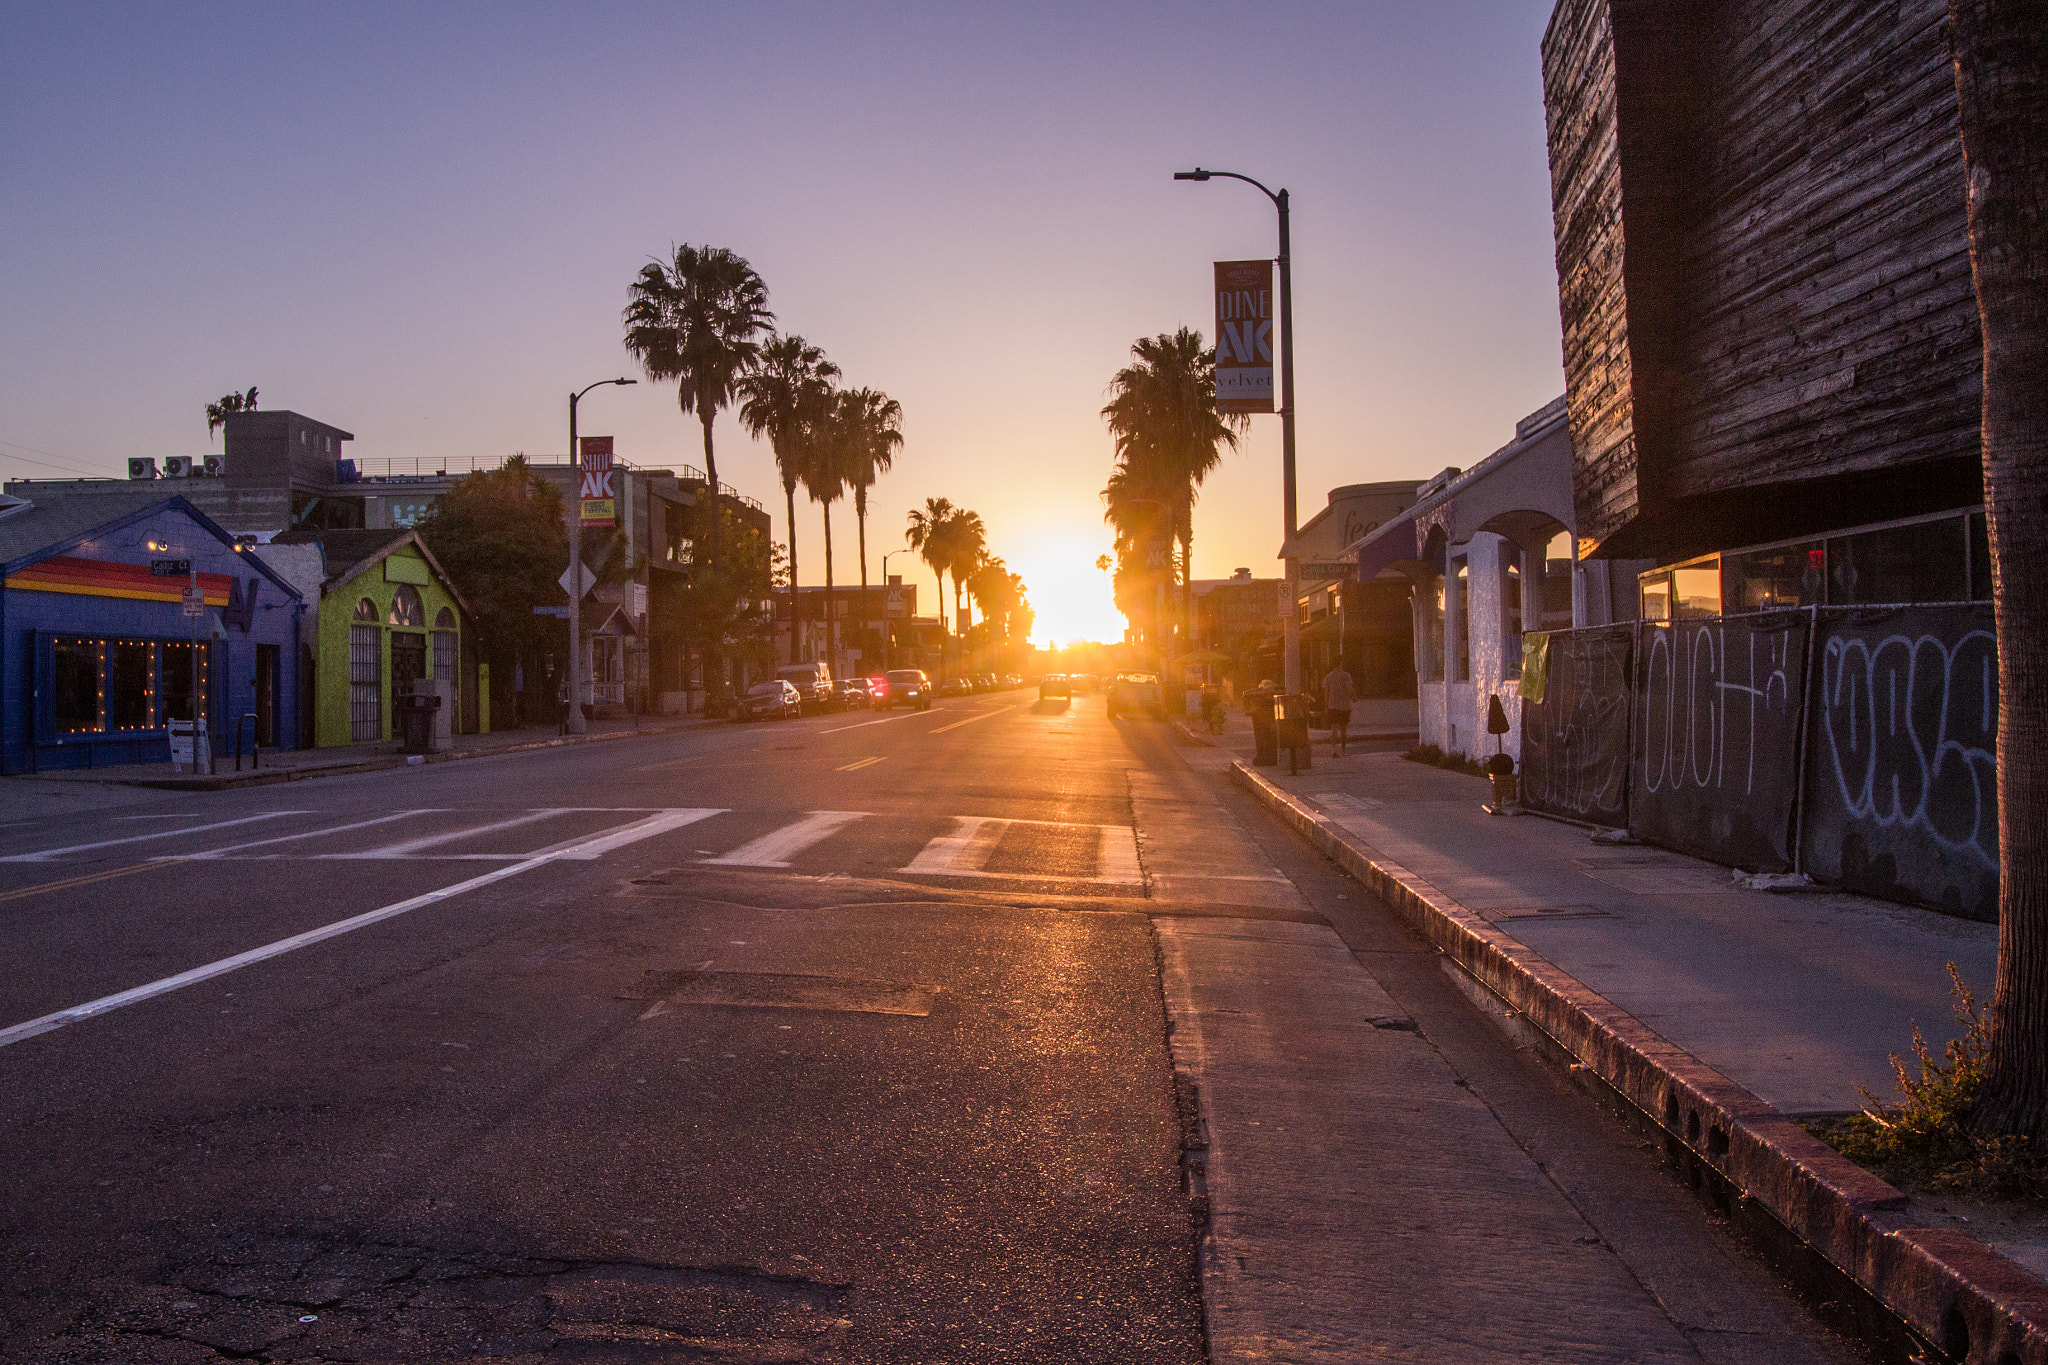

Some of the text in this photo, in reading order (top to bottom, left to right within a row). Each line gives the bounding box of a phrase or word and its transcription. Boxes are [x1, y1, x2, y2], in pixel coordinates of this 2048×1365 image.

[1219, 290, 1270, 320] DINE
[1216, 320, 1273, 363] AK
[1217, 373, 1272, 387] velvet
[581, 454, 613, 471] SHOP
[580, 471, 614, 498] AK
[1146, 551, 1167, 567] AK
[1328, 564, 1348, 573] Clara
[888, 590, 904, 602] AK
